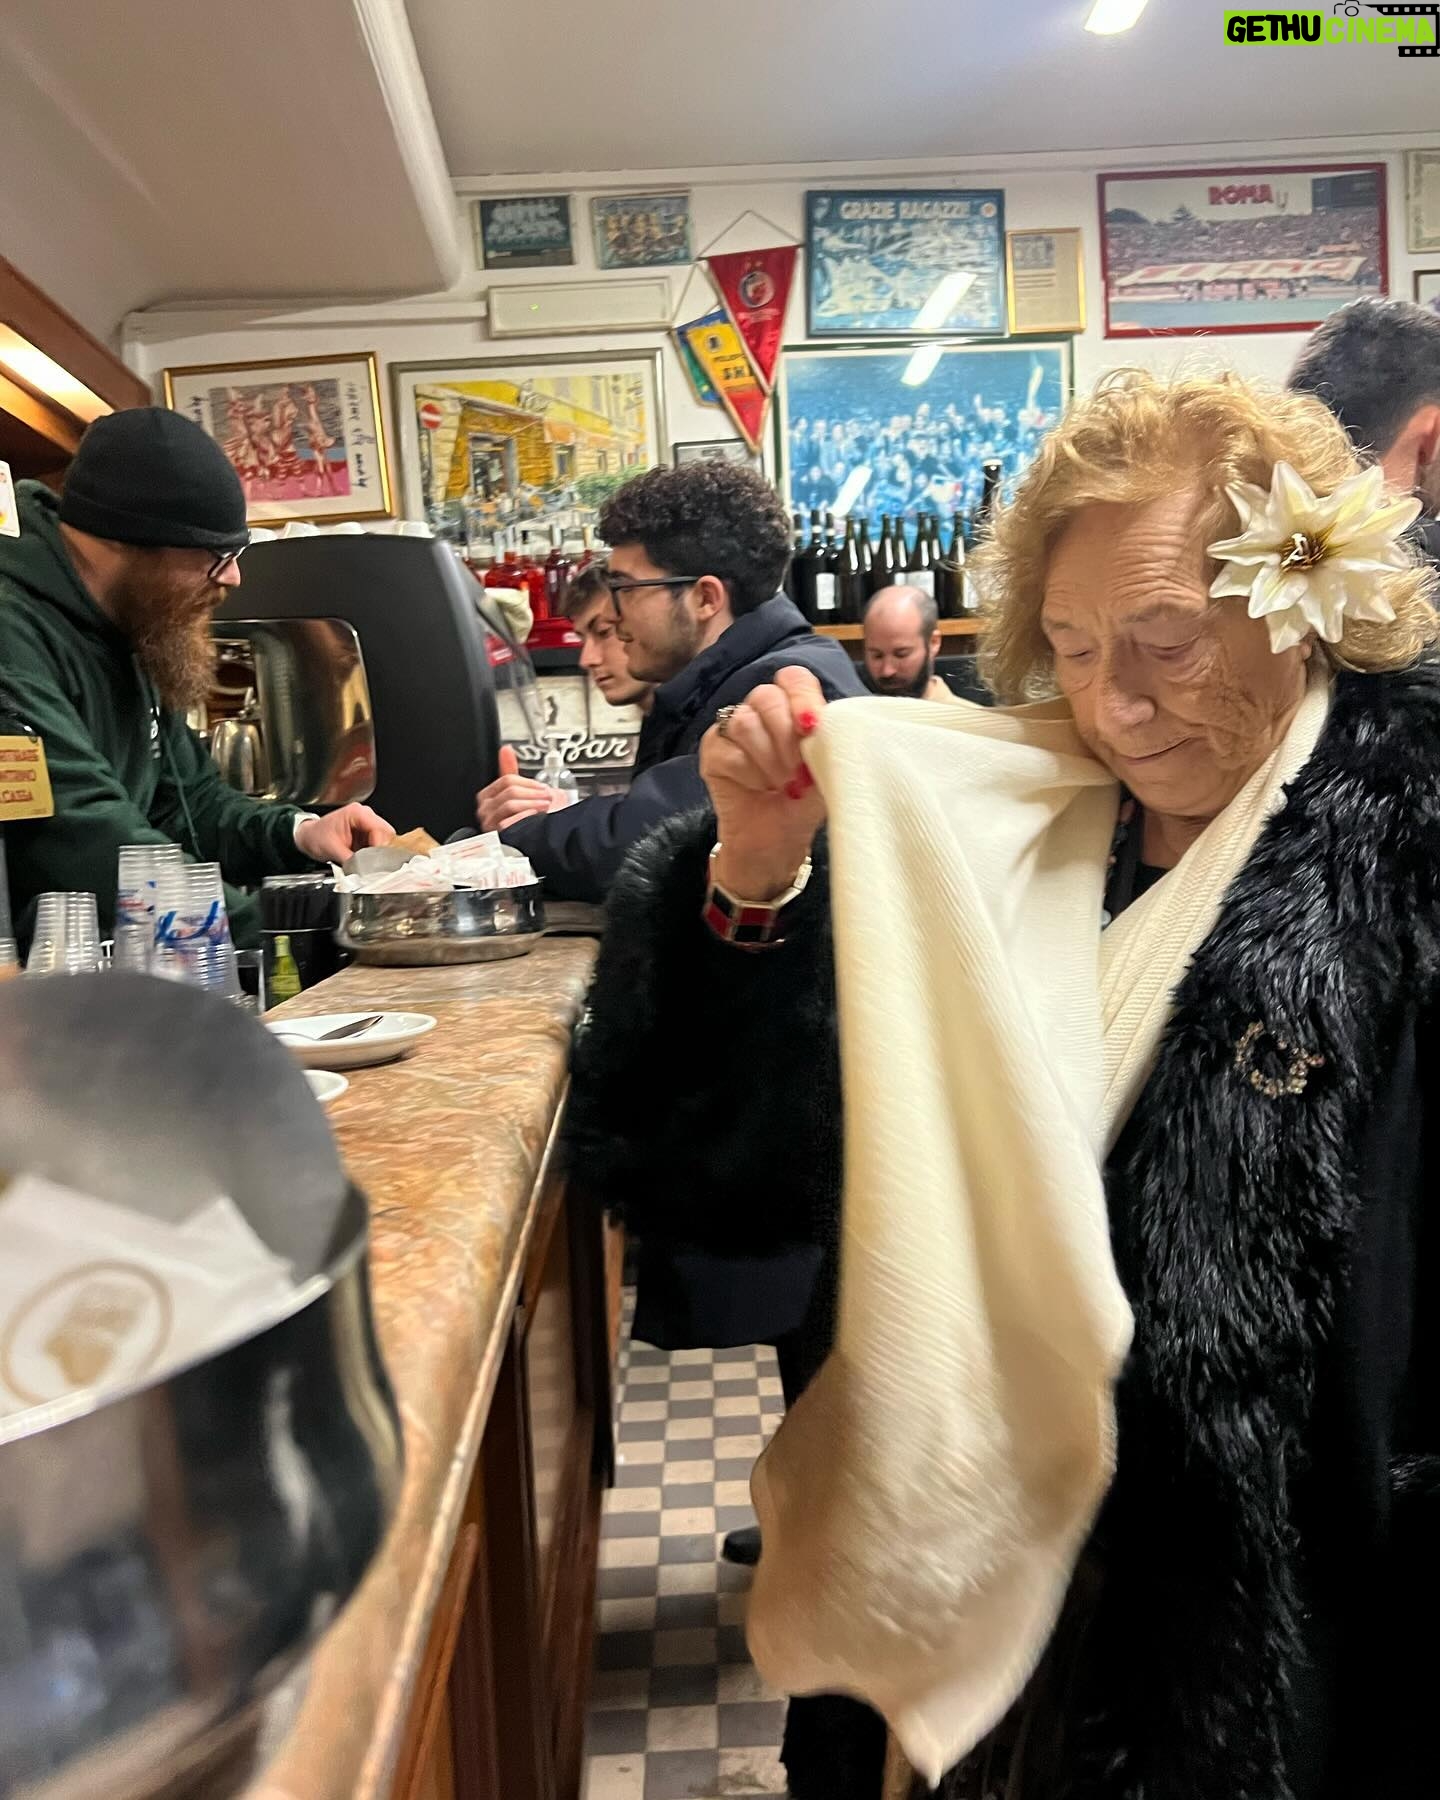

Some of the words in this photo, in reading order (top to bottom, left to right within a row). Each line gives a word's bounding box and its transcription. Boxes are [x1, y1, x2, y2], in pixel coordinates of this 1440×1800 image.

[1208, 184, 1274, 205] ROMA
[840, 201, 897, 220] GRAZIE
[544, 731, 630, 762] Bar
